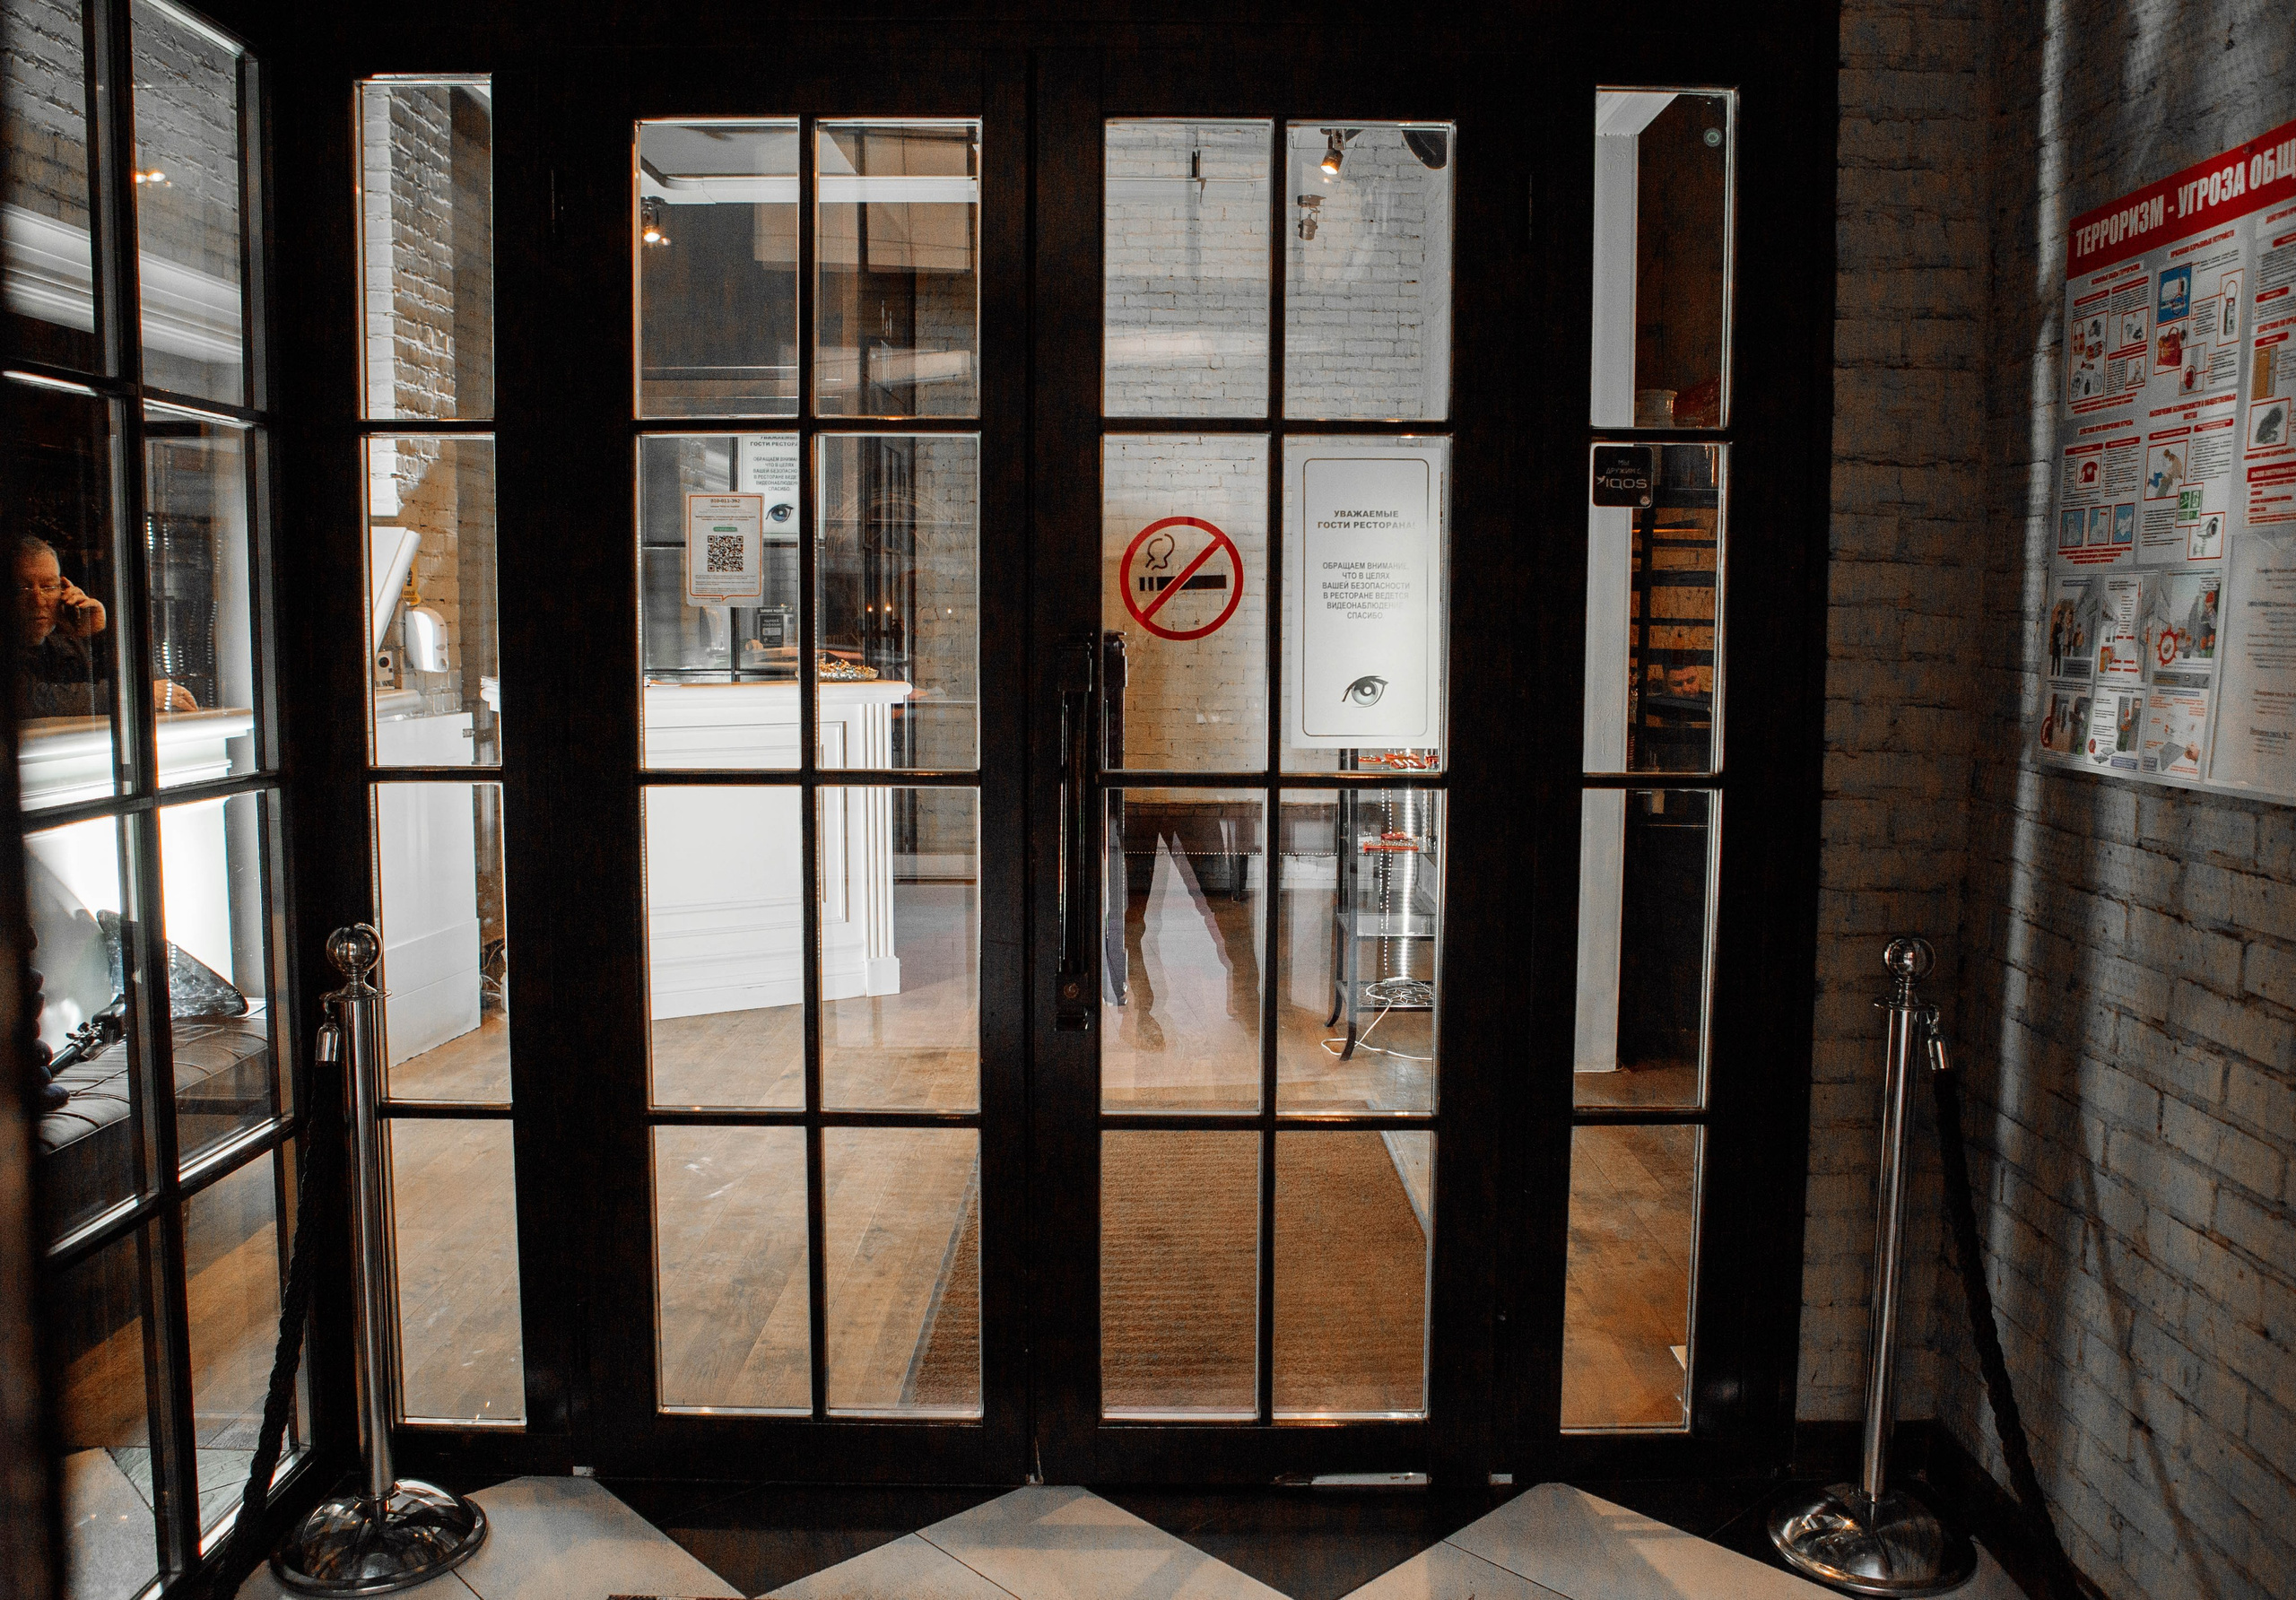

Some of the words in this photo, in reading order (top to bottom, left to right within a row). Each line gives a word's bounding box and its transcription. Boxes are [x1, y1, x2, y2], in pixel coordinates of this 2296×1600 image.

[2075, 195, 2164, 257] ТЕРРОРИЗМ
[2178, 161, 2245, 219] УГРОЗА
[2249, 137, 2296, 190] ОБЩ
[1605, 478, 1648, 490] IQOS
[1318, 521, 1351, 529] ГОСТИ
[1322, 561, 1365, 570] ОБРАЩАЕМ
[1366, 572, 1390, 580] ЦЕЛЯХ
[1322, 581, 1349, 589] ВАШЕЙ
